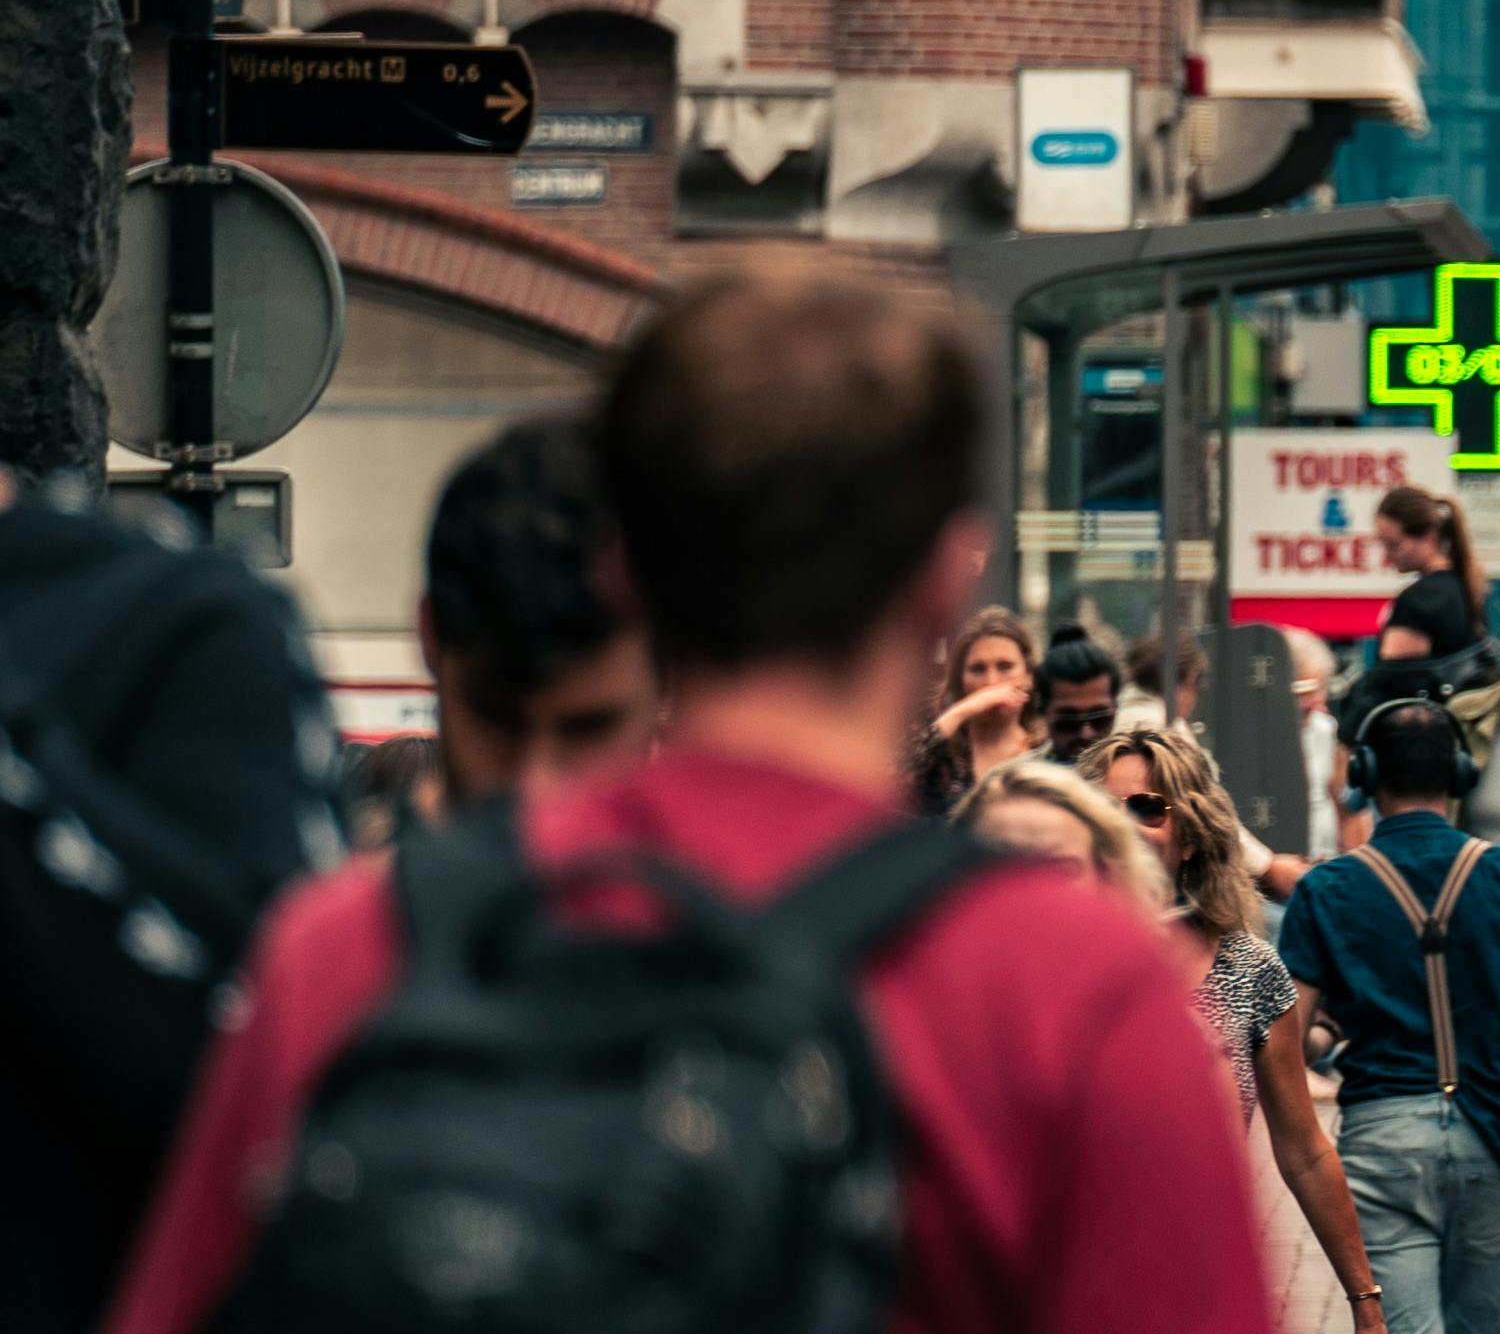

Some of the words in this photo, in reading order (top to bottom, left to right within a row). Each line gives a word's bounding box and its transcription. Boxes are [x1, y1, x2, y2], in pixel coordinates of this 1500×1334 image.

[229, 55, 373, 84] Vijzelgracht
[443, 63, 480, 85] 0,6
[1271, 450, 1407, 490] TOURS
[1321, 491, 1351, 532] &
